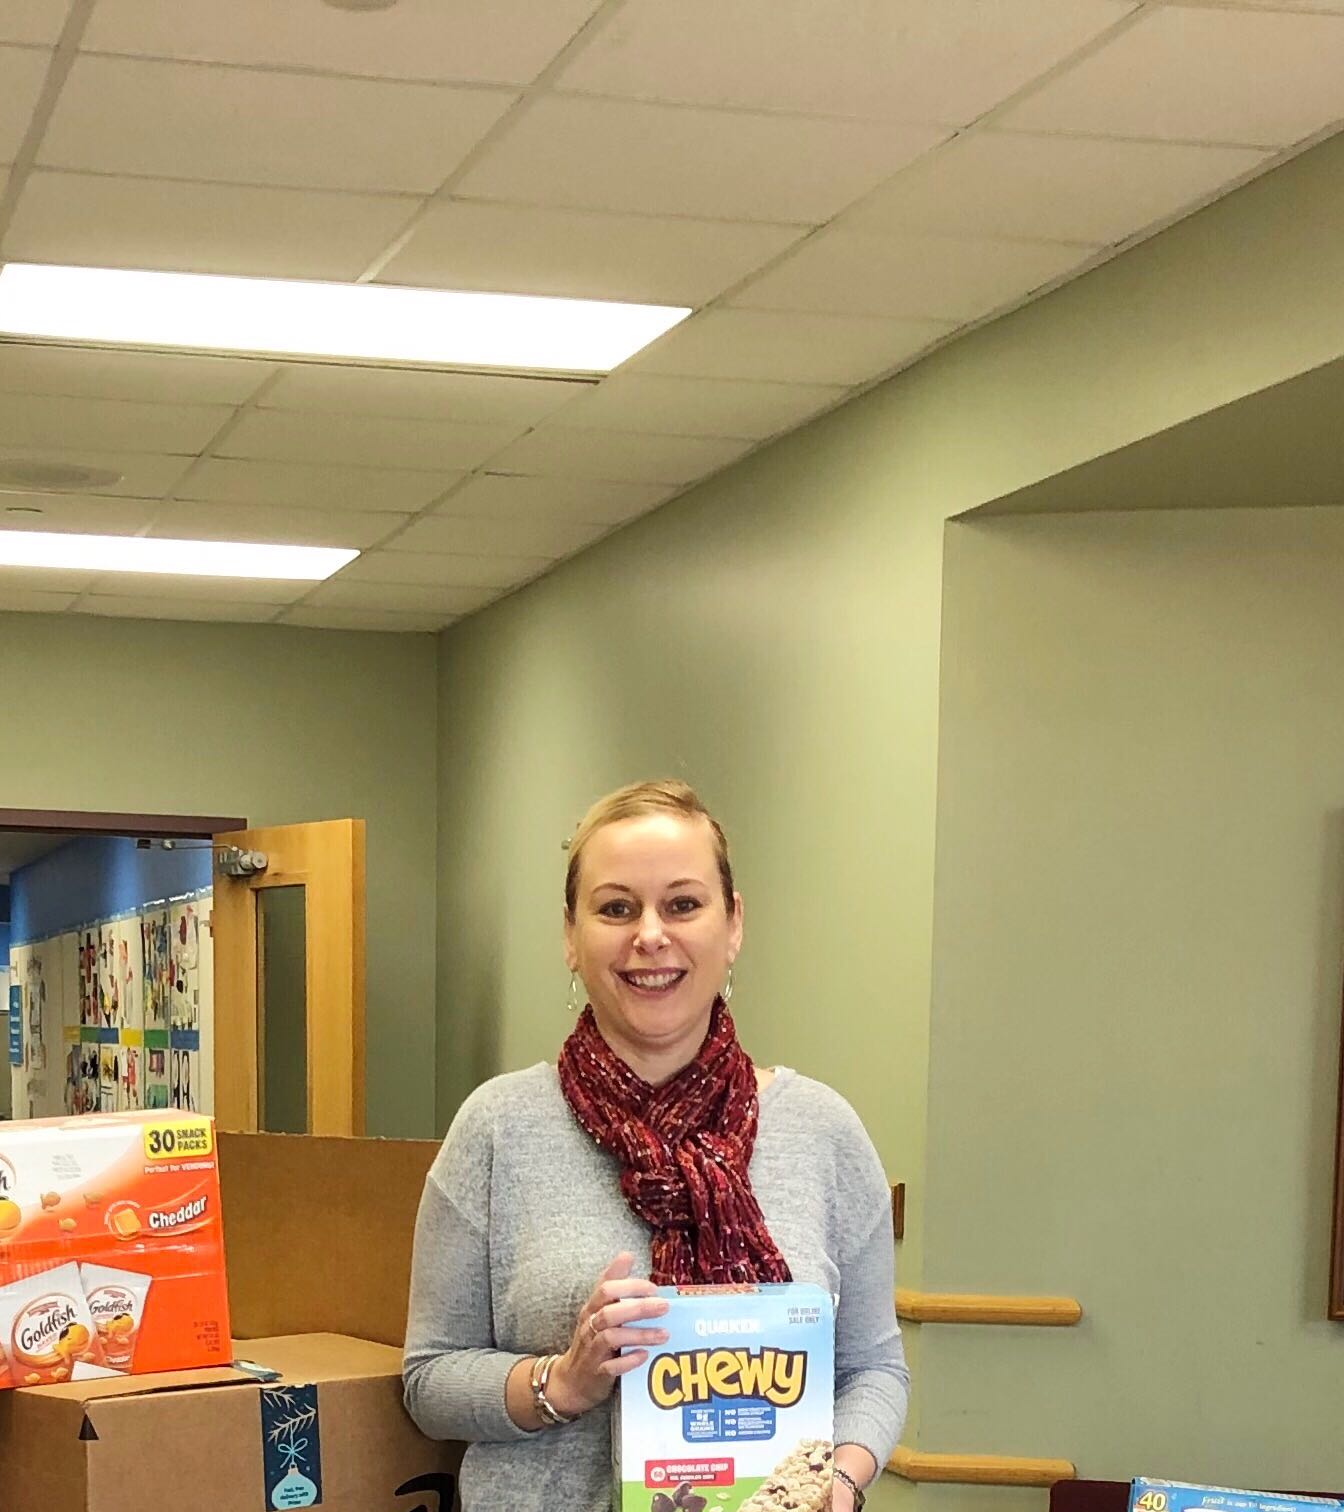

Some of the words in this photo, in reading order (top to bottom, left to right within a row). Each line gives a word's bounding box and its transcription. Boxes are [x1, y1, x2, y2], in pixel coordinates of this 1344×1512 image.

[148, 1129, 176, 1154] 30
[176, 1127, 208, 1140] SNACK
[177, 1140, 208, 1152] PACKS
[148, 1195, 209, 1229] Cheddar
[88, 1300, 134, 1316] Goldfish
[20, 1304, 77, 1351] Goldfish
[666, 1464, 709, 1474] CHOCOLATE
[710, 1463, 729, 1473] CHIP
[1139, 1491, 1166, 1512] 40
[1201, 1496, 1226, 1507] Fruit
